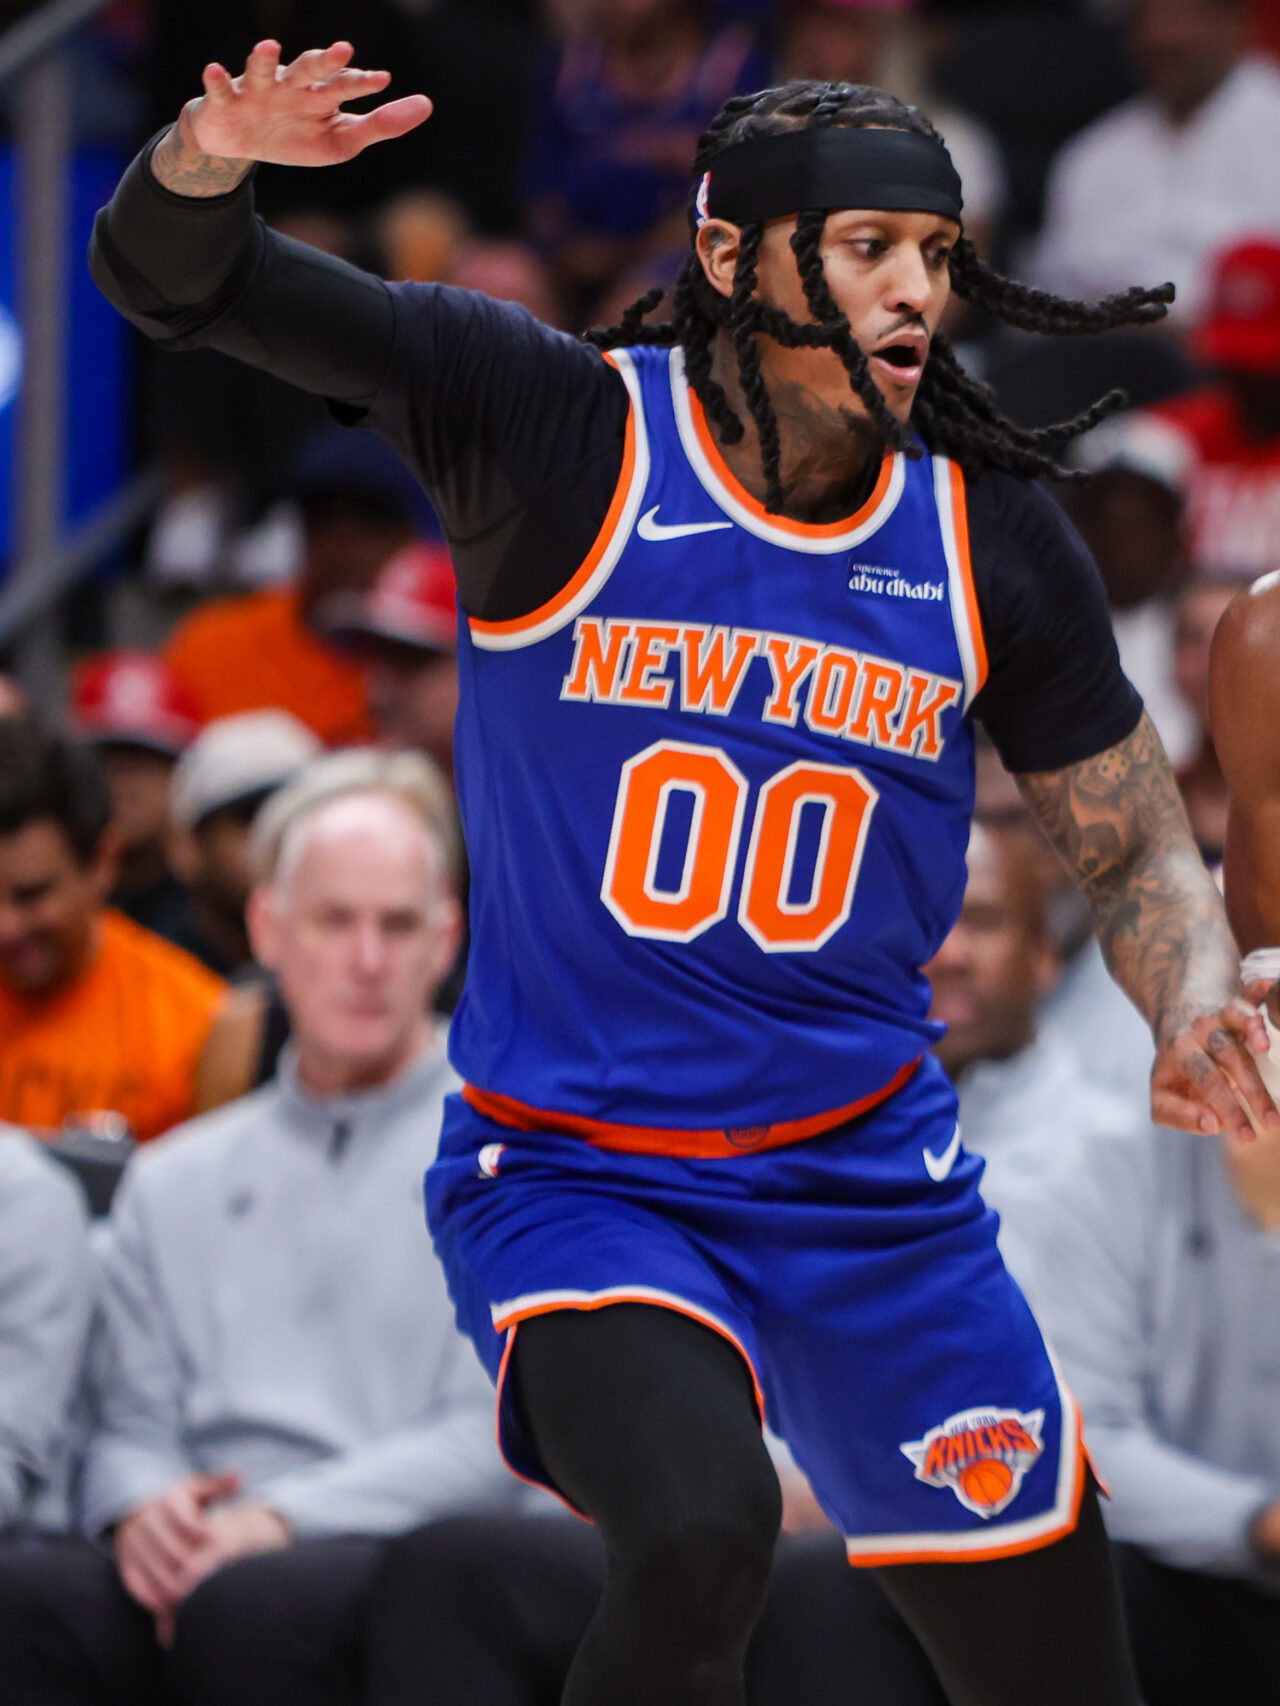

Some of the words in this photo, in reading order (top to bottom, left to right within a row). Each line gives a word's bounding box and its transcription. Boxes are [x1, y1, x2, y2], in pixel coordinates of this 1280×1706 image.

[848, 574, 884, 594] abu
[886, 578, 944, 601] dhabi
[853, 563, 899, 578] experience
[559, 616, 759, 717] NEW
[762, 631, 962, 762] YORK
[600, 738, 880, 954] 00
[923, 1418, 1038, 1478] KNICKS
